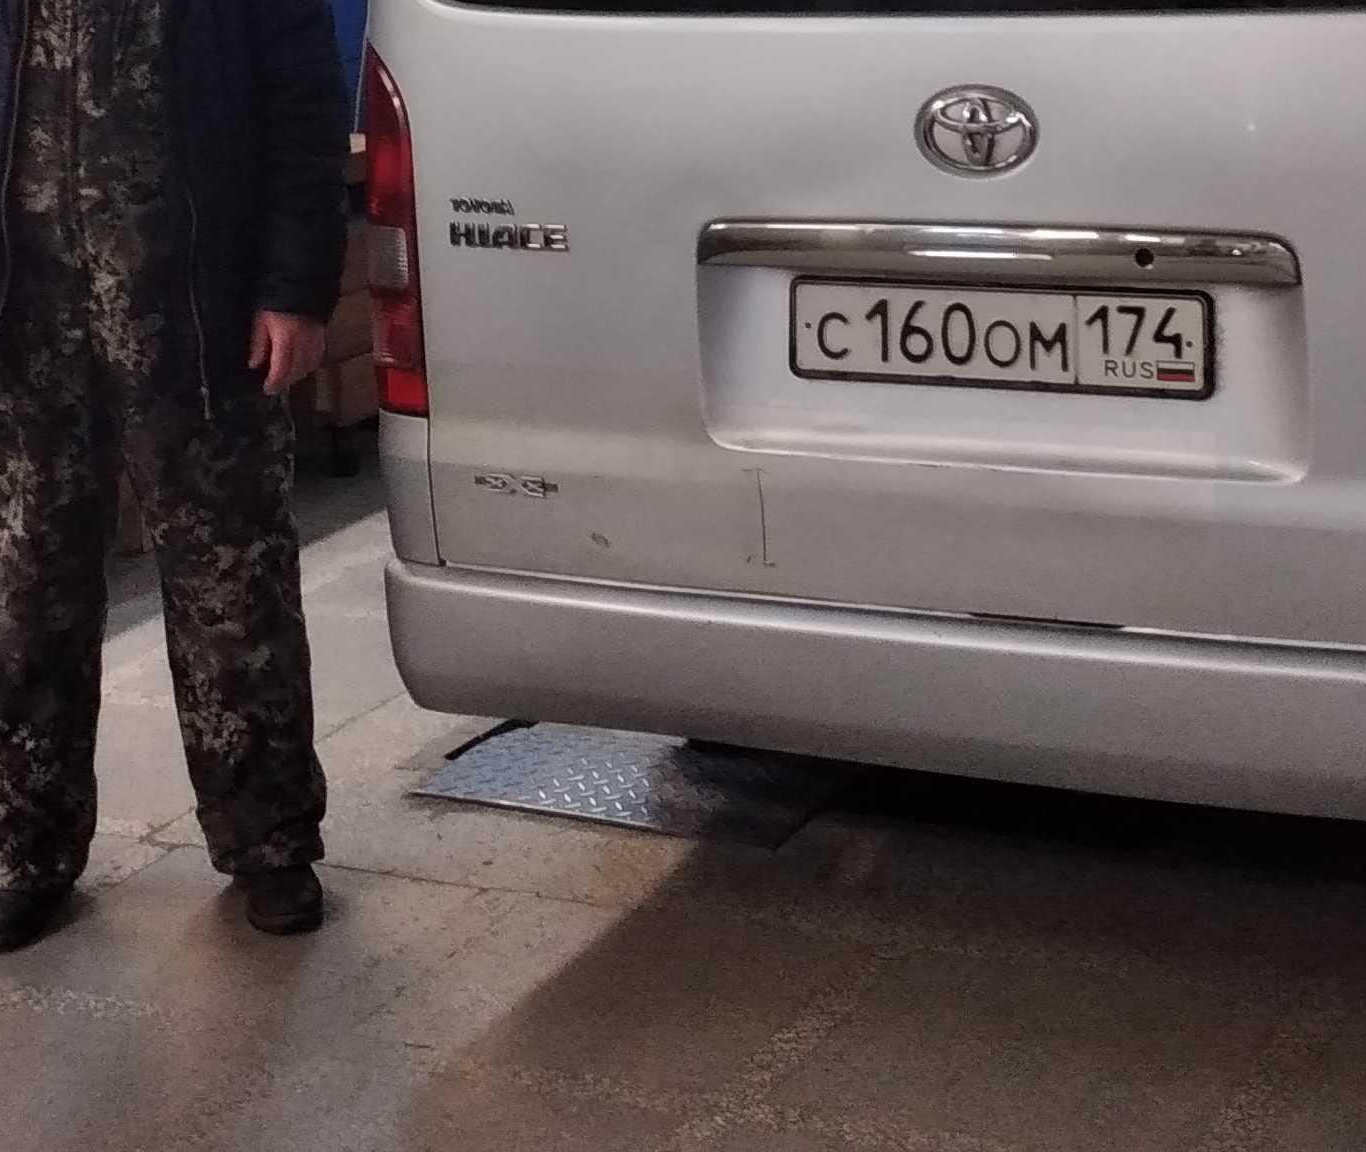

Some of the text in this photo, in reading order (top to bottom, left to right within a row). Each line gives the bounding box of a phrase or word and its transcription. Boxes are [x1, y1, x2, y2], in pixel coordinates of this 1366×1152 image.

[448, 222, 571, 252] HIACE
[1086, 305, 1183, 359] 174
[1104, 359, 1155, 379] RUS
